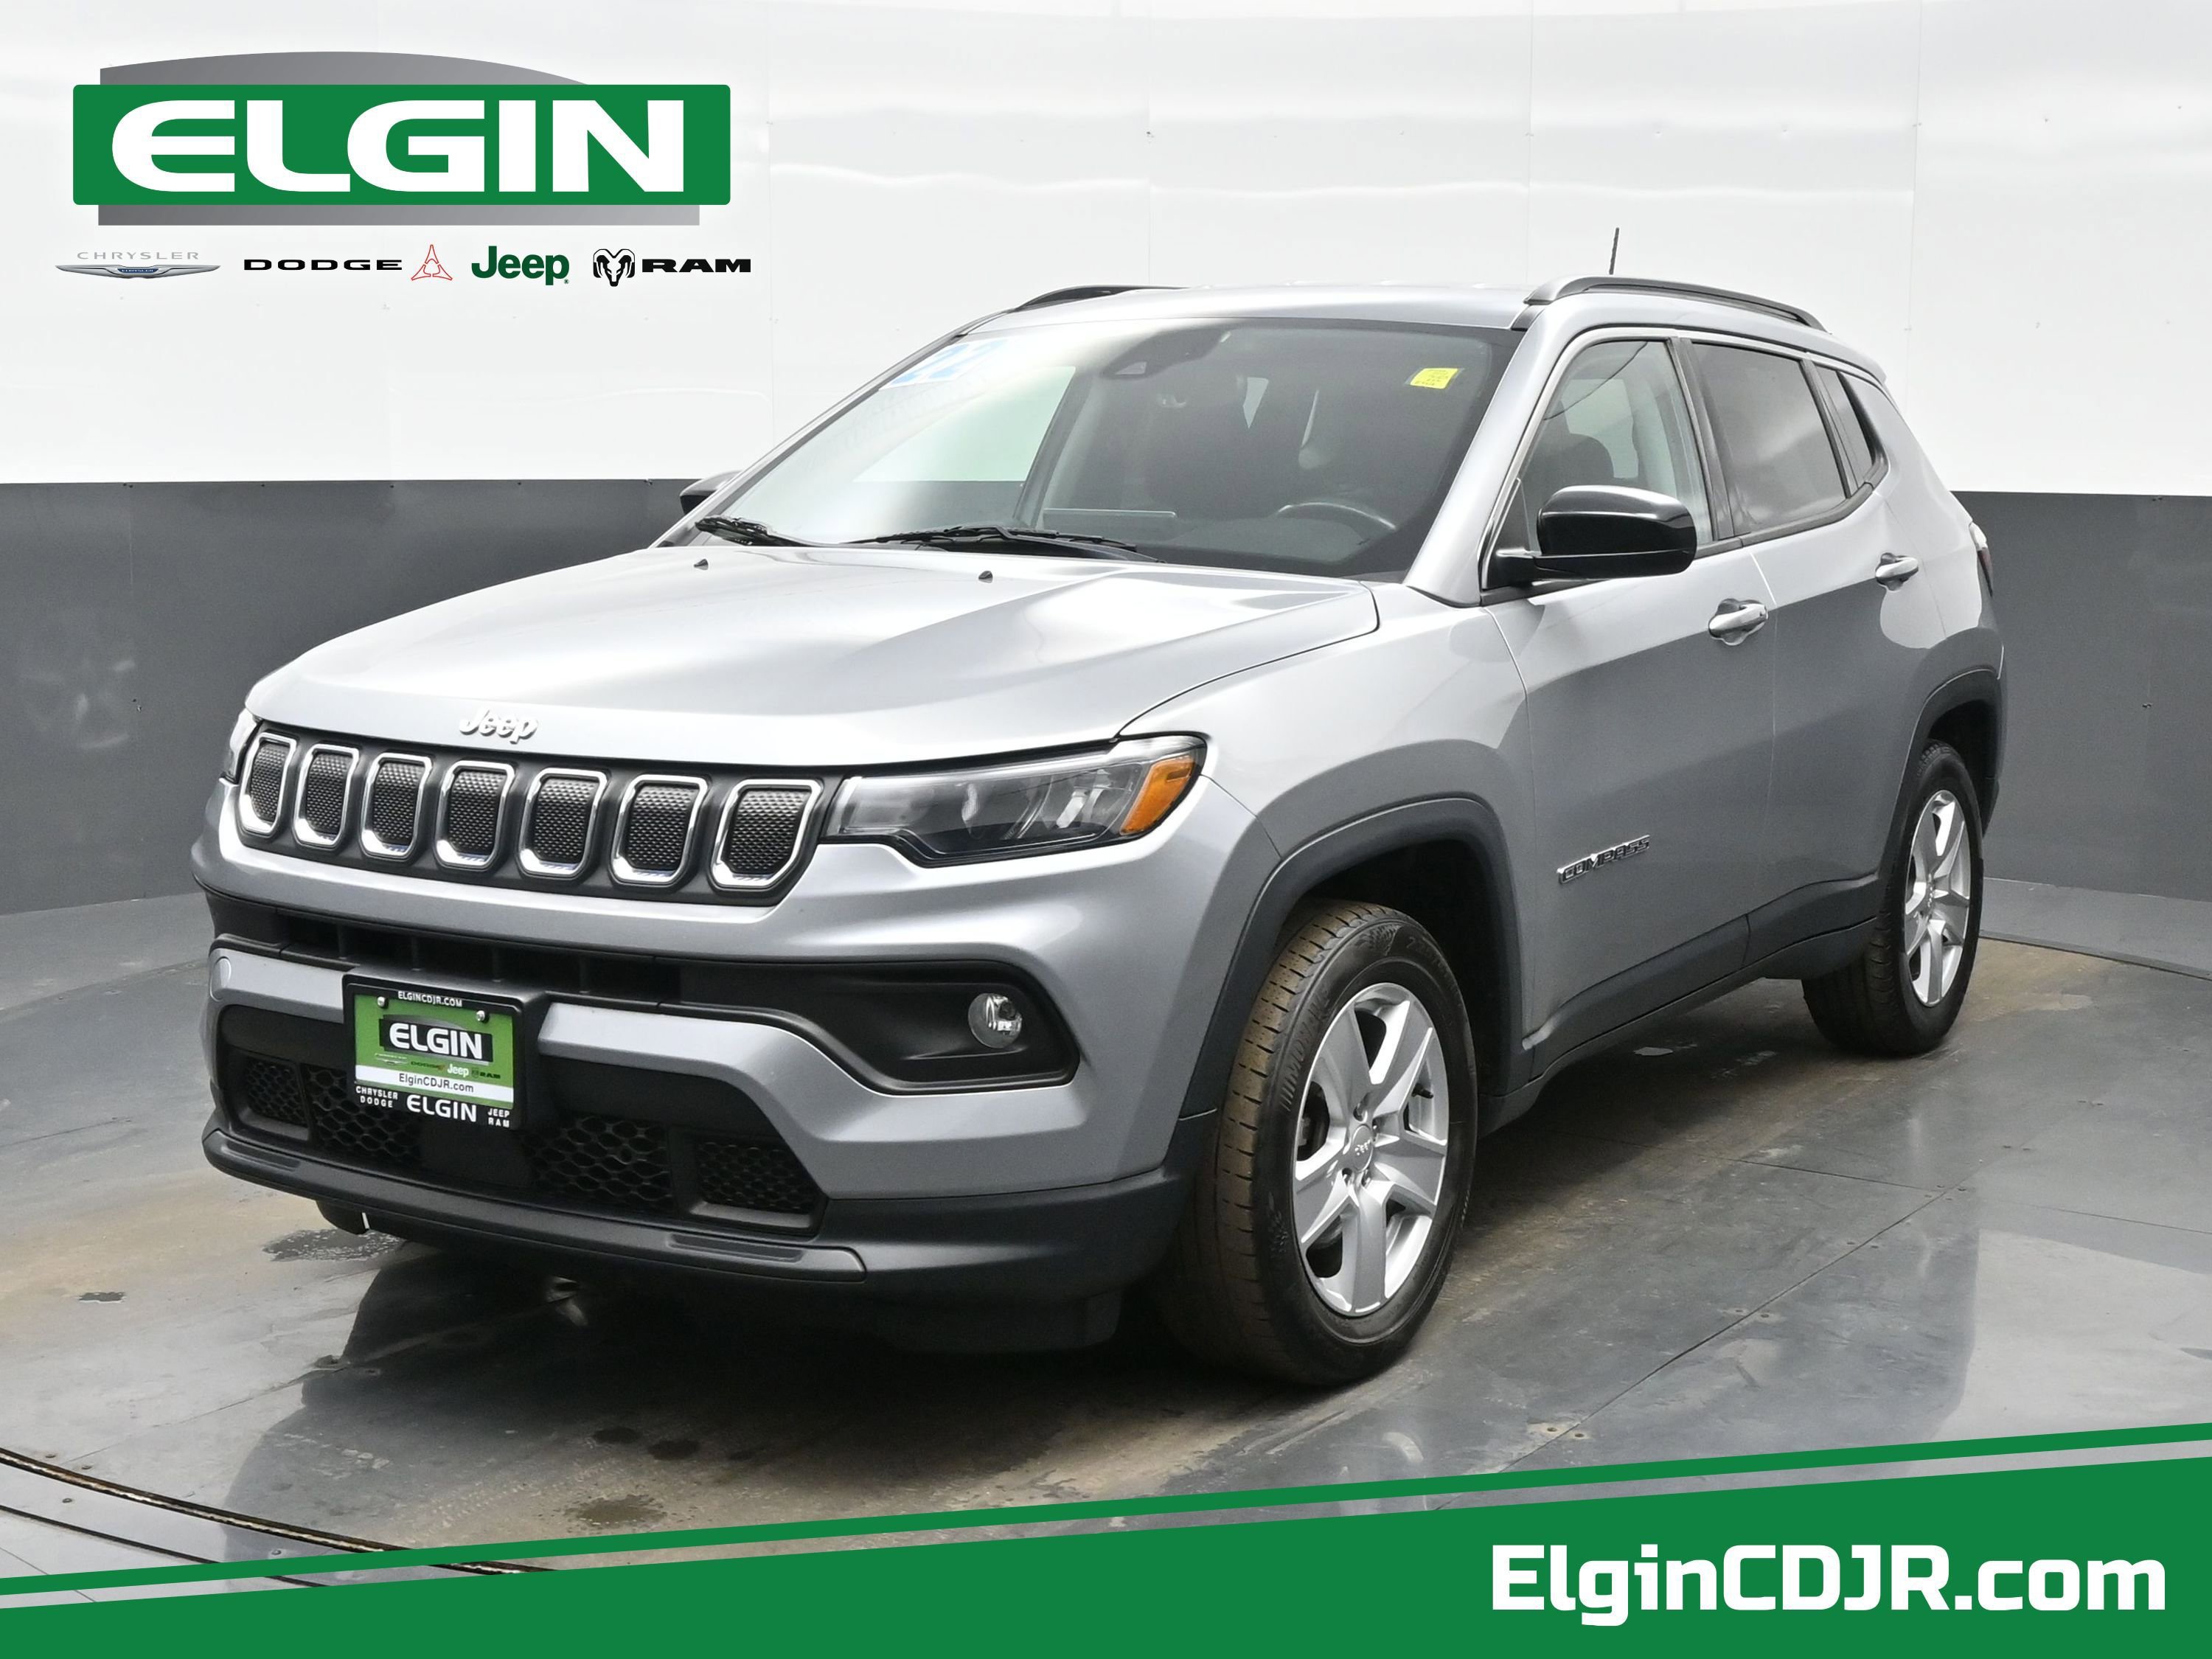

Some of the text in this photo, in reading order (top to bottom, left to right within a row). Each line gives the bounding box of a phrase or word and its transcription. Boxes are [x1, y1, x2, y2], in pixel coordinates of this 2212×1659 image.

[459, 709, 538, 745] Jeep
[1557, 834, 1650, 884] COMPASS
[397, 990, 463, 1008] ELGINCDJR.COM
[389, 1022, 483, 1060] ELGIN
[447, 1063, 470, 1078] Jeep
[355, 1085, 398, 1099] CHRYSLER
[399, 1073, 474, 1093] ElginCDJR.com
[360, 1095, 393, 1108] DODGE
[406, 1094, 477, 1122] ELGIN
[487, 1107, 510, 1118] JEEP
[487, 1117, 510, 1128] RAM
